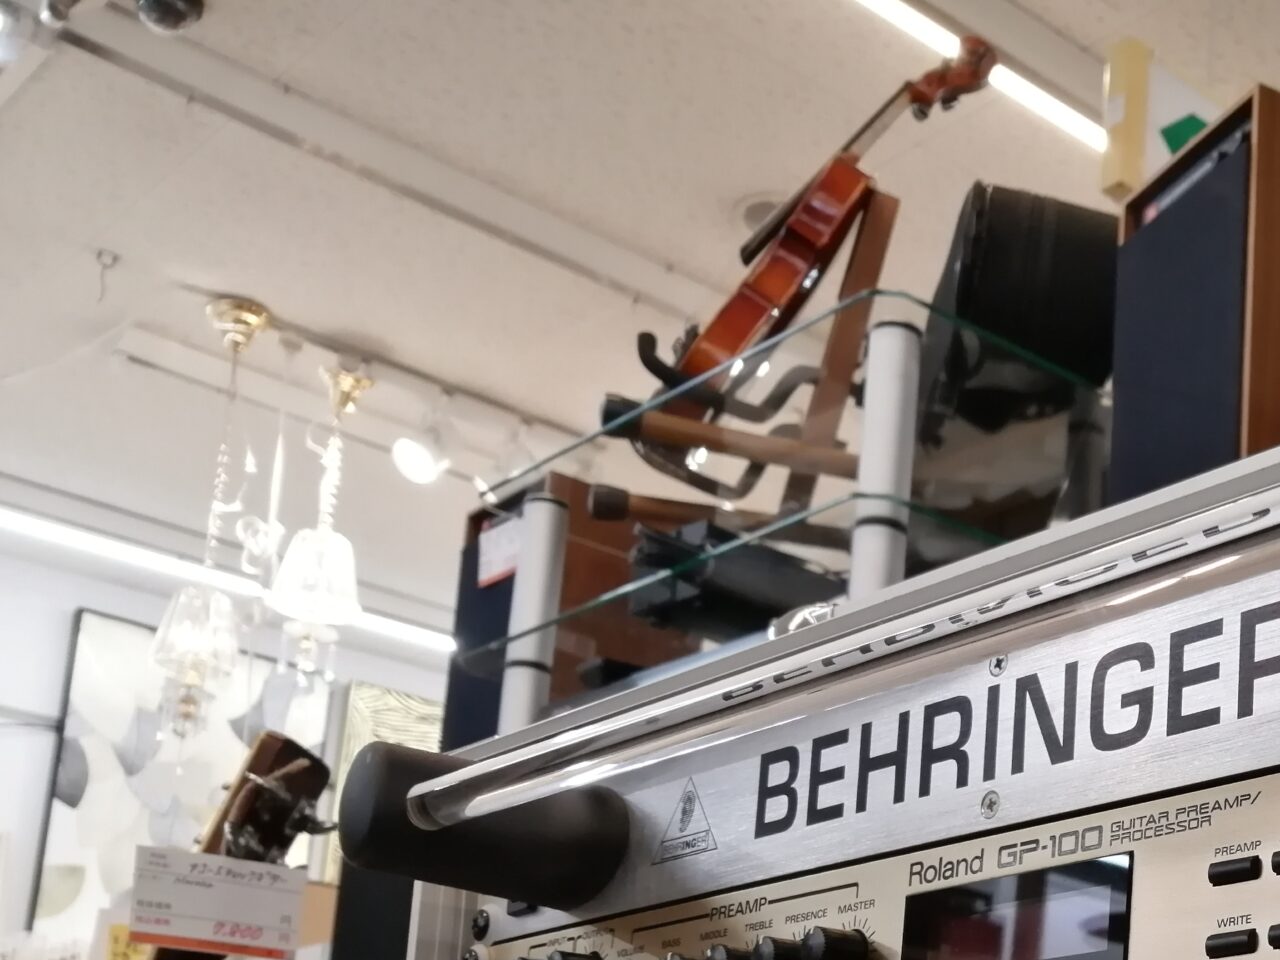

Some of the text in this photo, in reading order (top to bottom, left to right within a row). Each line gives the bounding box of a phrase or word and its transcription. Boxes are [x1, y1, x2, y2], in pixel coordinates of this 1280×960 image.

[1109, 814, 1212, 847] PROCESSOR
[1110, 810, 1170, 834] GUITAR
[908, 824, 1104, 887] Roland GP-100
[1213, 839, 1262, 858] PREAMP
[709, 896, 768, 922] PREAMP
[784, 907, 829, 925] PRESENCE
[837, 898, 876, 915] MASTER
[745, 918, 774, 933] TREBLE
[1216, 913, 1252, 929] WRITE
